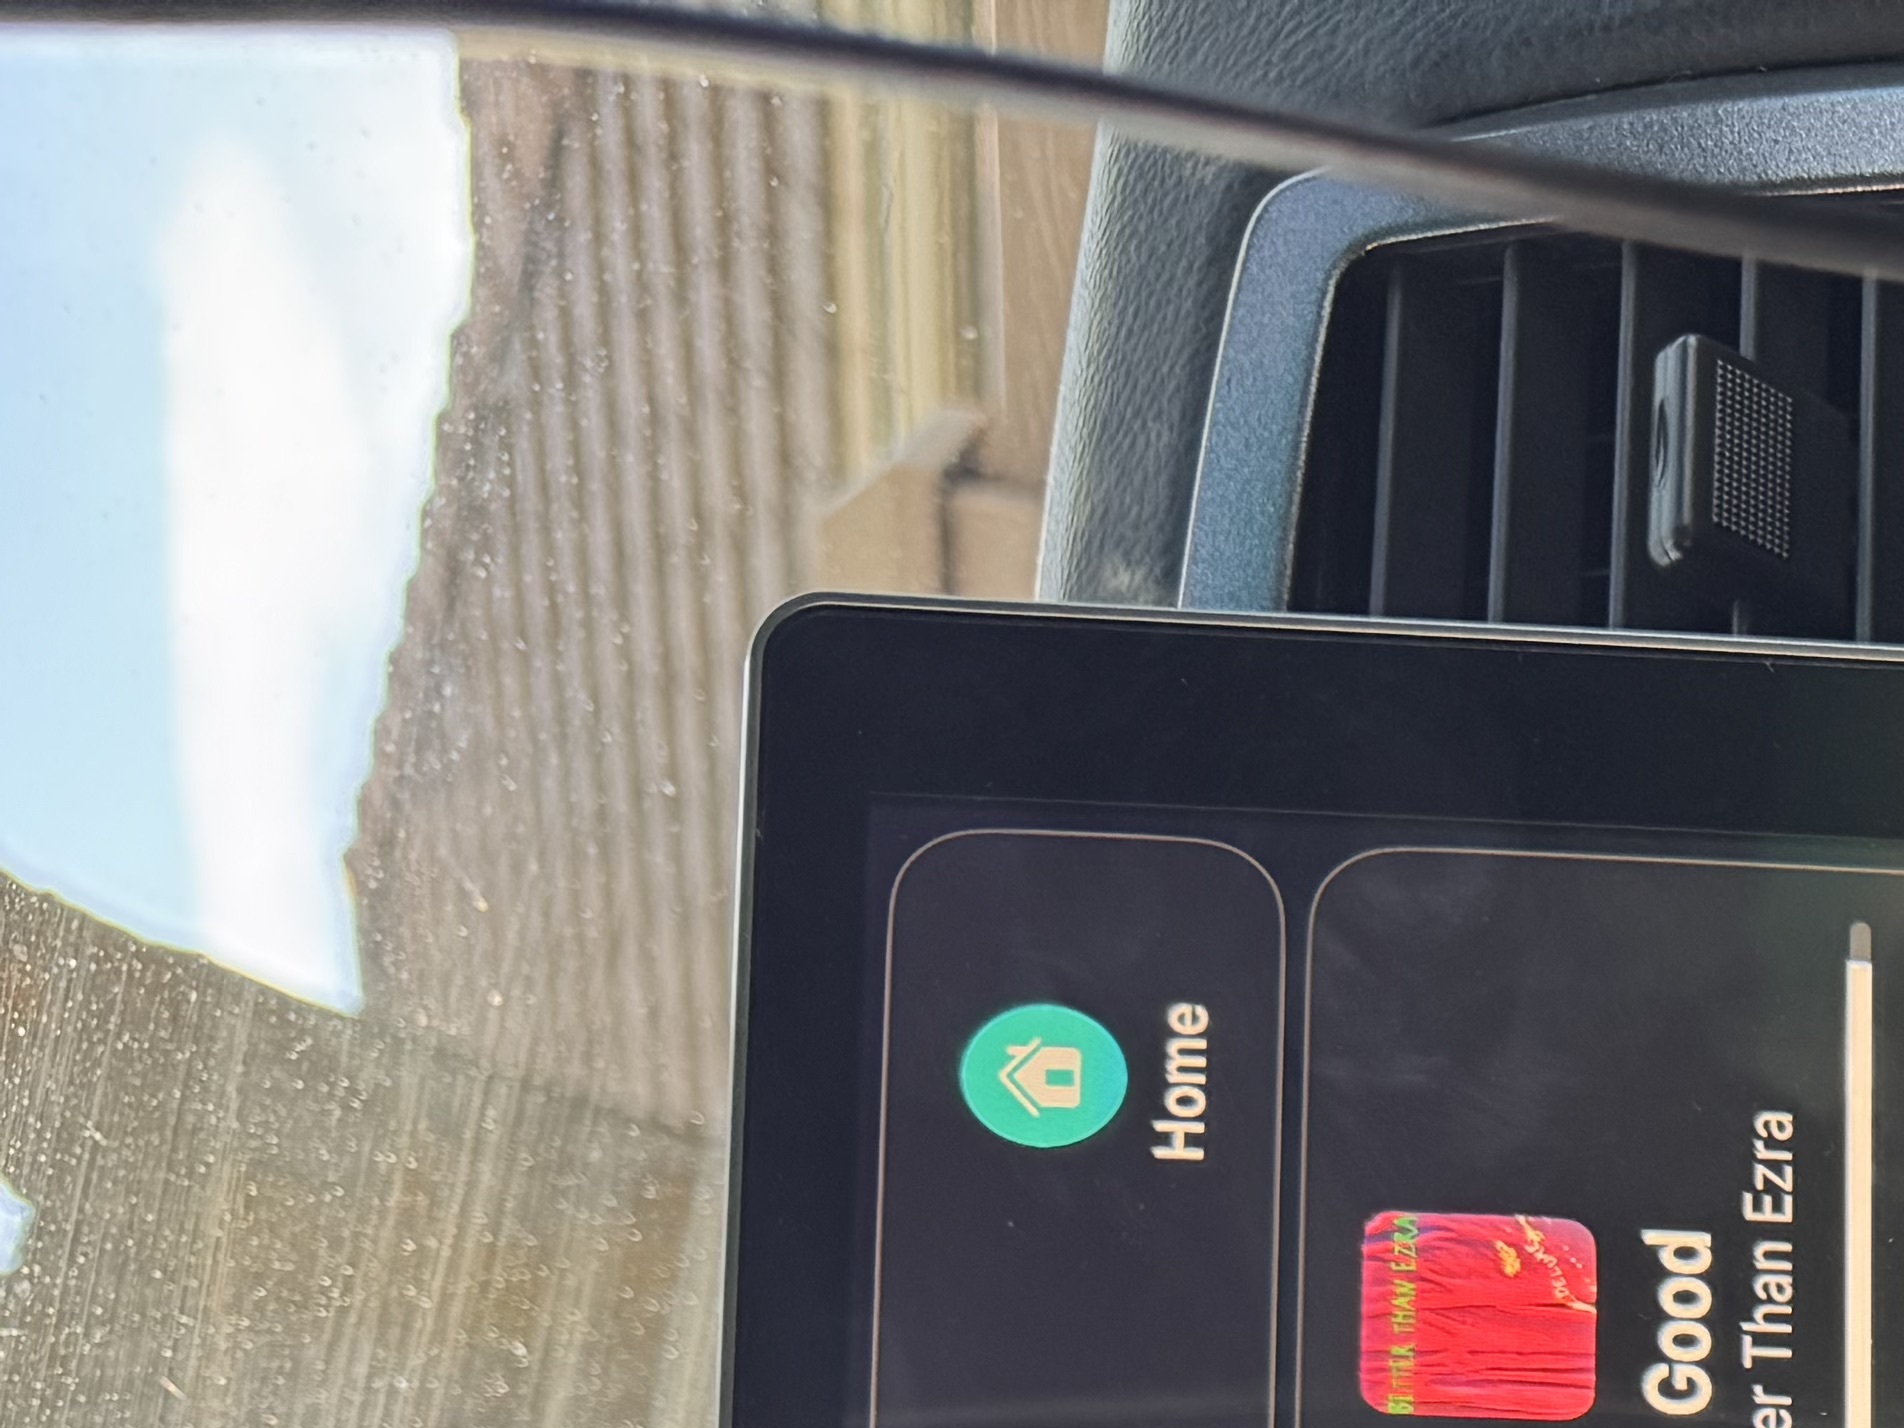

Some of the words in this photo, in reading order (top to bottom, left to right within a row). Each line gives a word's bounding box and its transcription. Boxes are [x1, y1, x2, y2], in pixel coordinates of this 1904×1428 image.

[1152, 1001, 1211, 1162] Home
[1744, 1110, 1797, 1226] Ezra
[1391, 1215, 1419, 1272] EZRA
[1742, 1240, 1796, 1370] Than
[1390, 1280, 1417, 1333] THAN
[1643, 1228, 1716, 1416] Good
